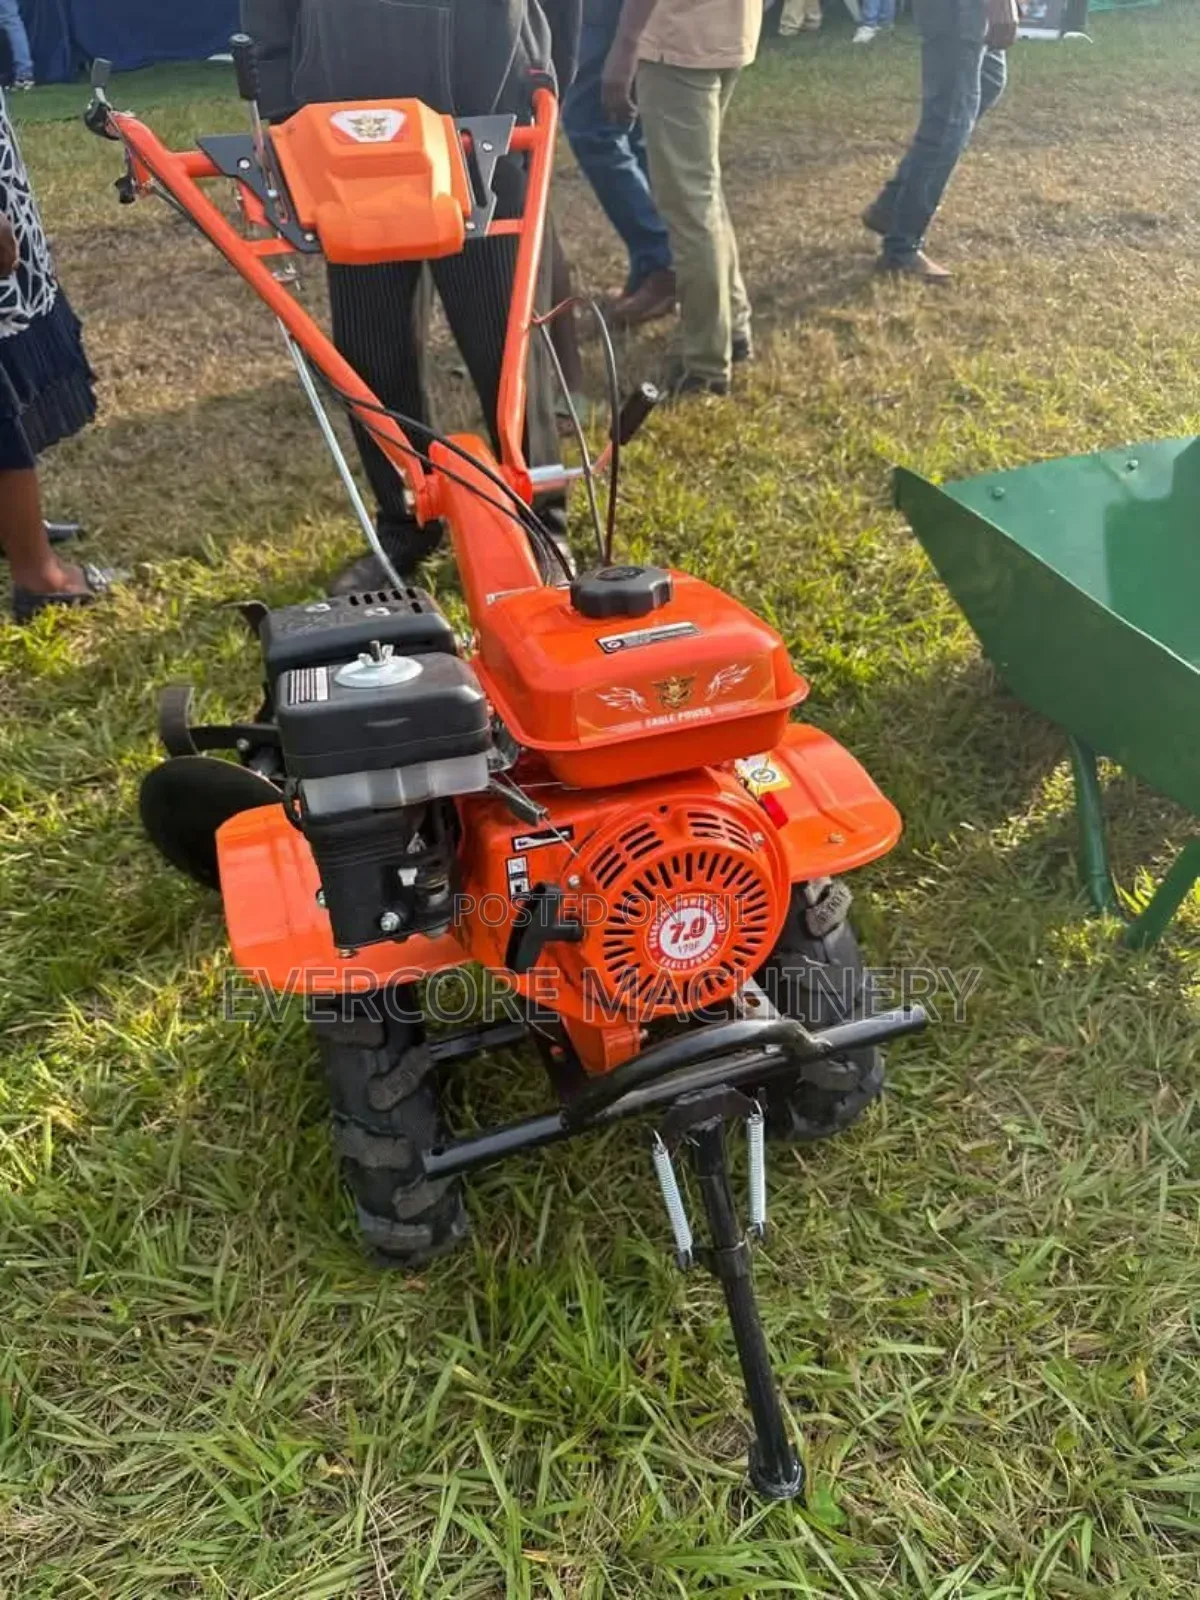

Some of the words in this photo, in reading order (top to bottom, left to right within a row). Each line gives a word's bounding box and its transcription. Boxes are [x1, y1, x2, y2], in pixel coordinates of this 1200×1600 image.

[645, 714, 676, 729] EAGLE
[678, 706, 712, 722] POWER
[669, 917, 708, 944] 7.0
[659, 955, 688, 970] EAGLE
[689, 943, 719, 968] POWER
